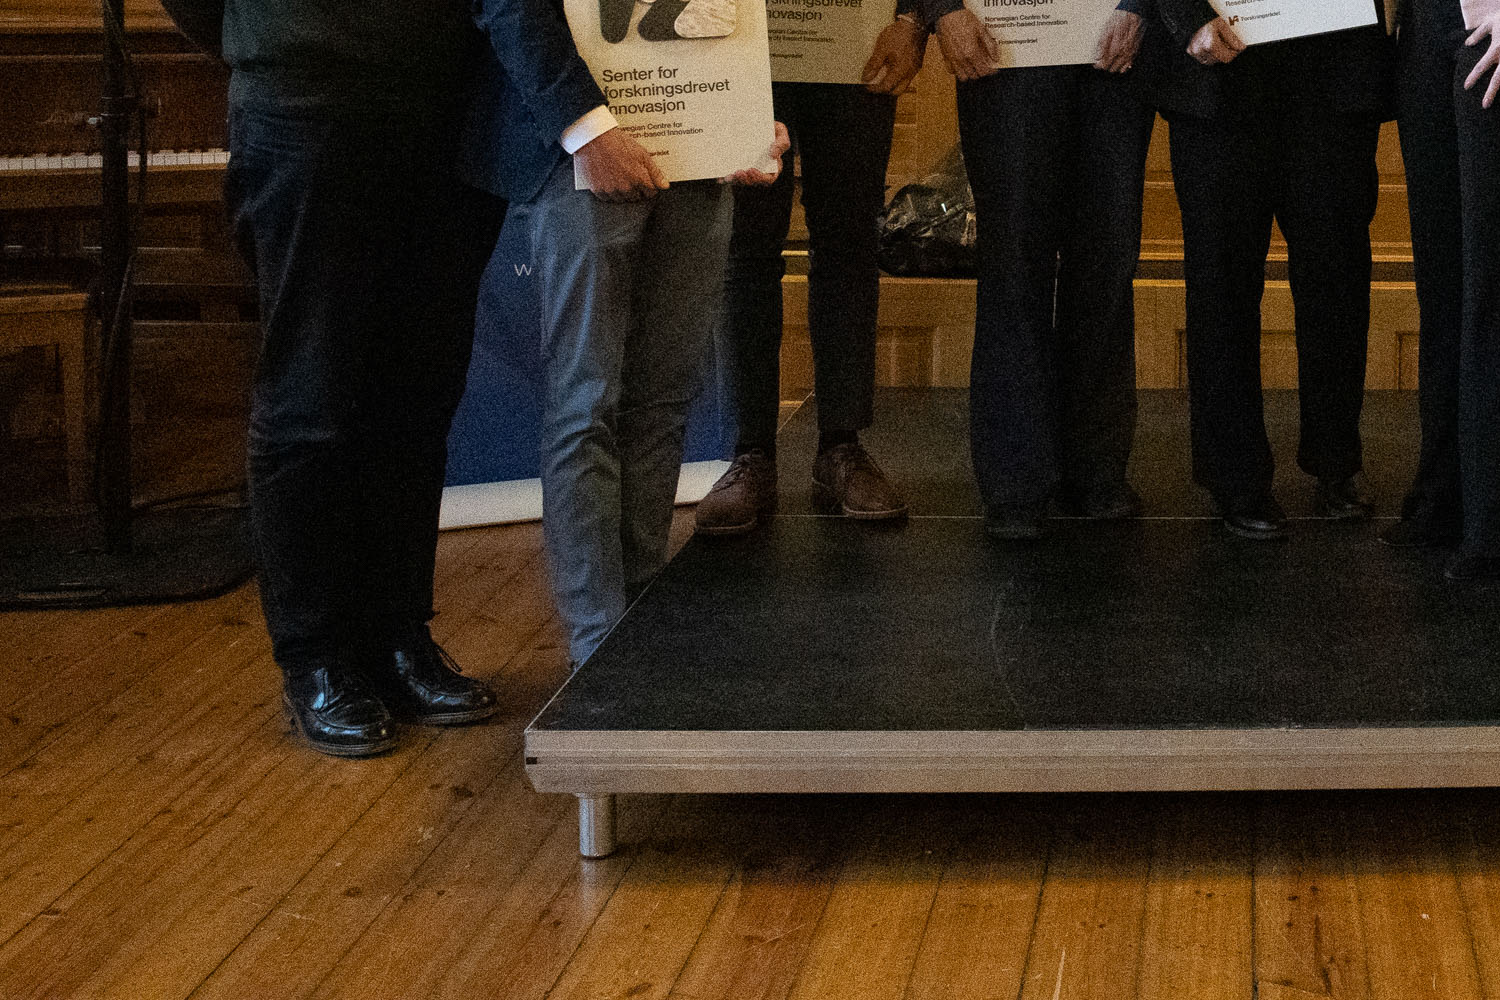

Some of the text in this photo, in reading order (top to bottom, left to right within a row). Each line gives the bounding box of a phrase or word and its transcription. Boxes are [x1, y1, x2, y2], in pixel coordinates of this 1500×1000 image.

[602, 66, 679, 83] Senter for
[604, 79, 730, 99] forskningsdrevet
[609, 100, 686, 115] nnovasjon
[647, 123, 672, 131] Centre
[673, 121, 683, 129] for
[667, 127, 704, 137] Innovation
